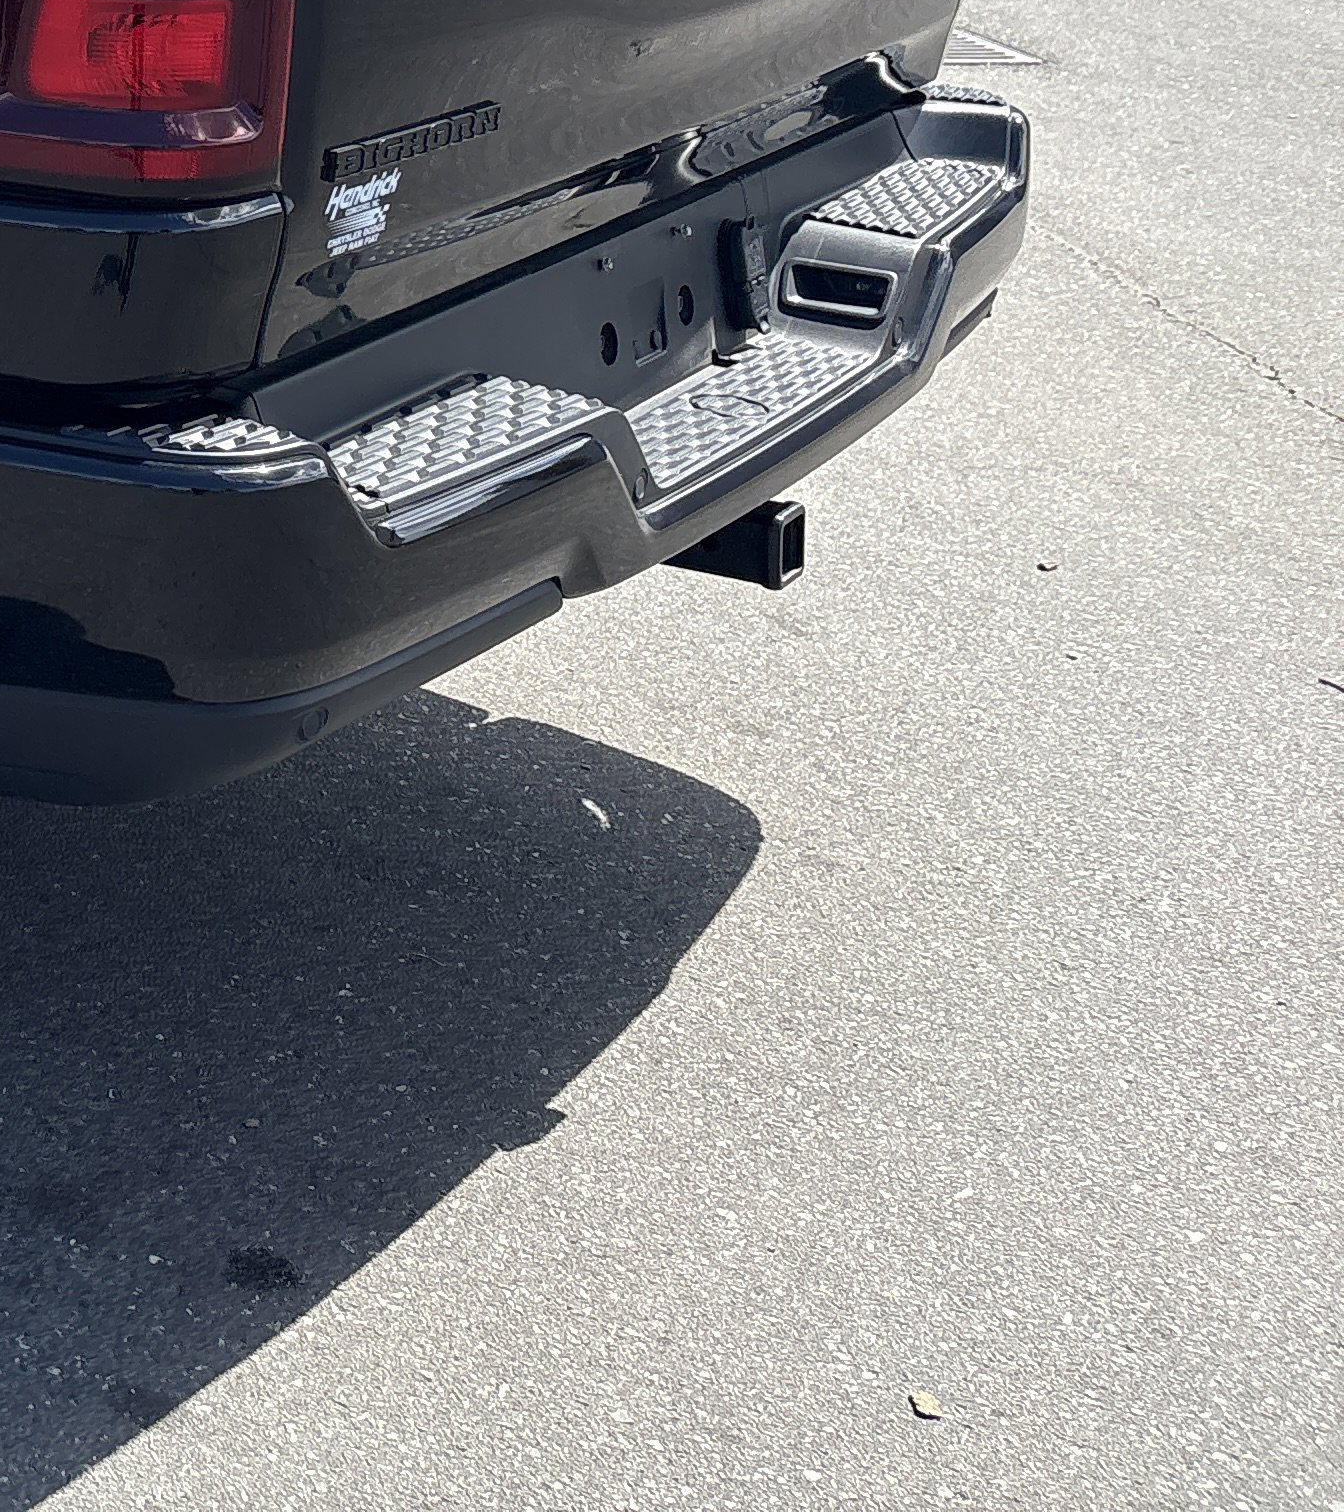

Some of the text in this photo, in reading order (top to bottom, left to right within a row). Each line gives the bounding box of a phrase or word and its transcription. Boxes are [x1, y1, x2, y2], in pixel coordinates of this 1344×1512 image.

[324, 166, 402, 221] Hendrick
[326, 229, 363, 249] CHRYSLER
[328, 243, 348, 257] JEEP
[348, 238, 364, 251] RAM
